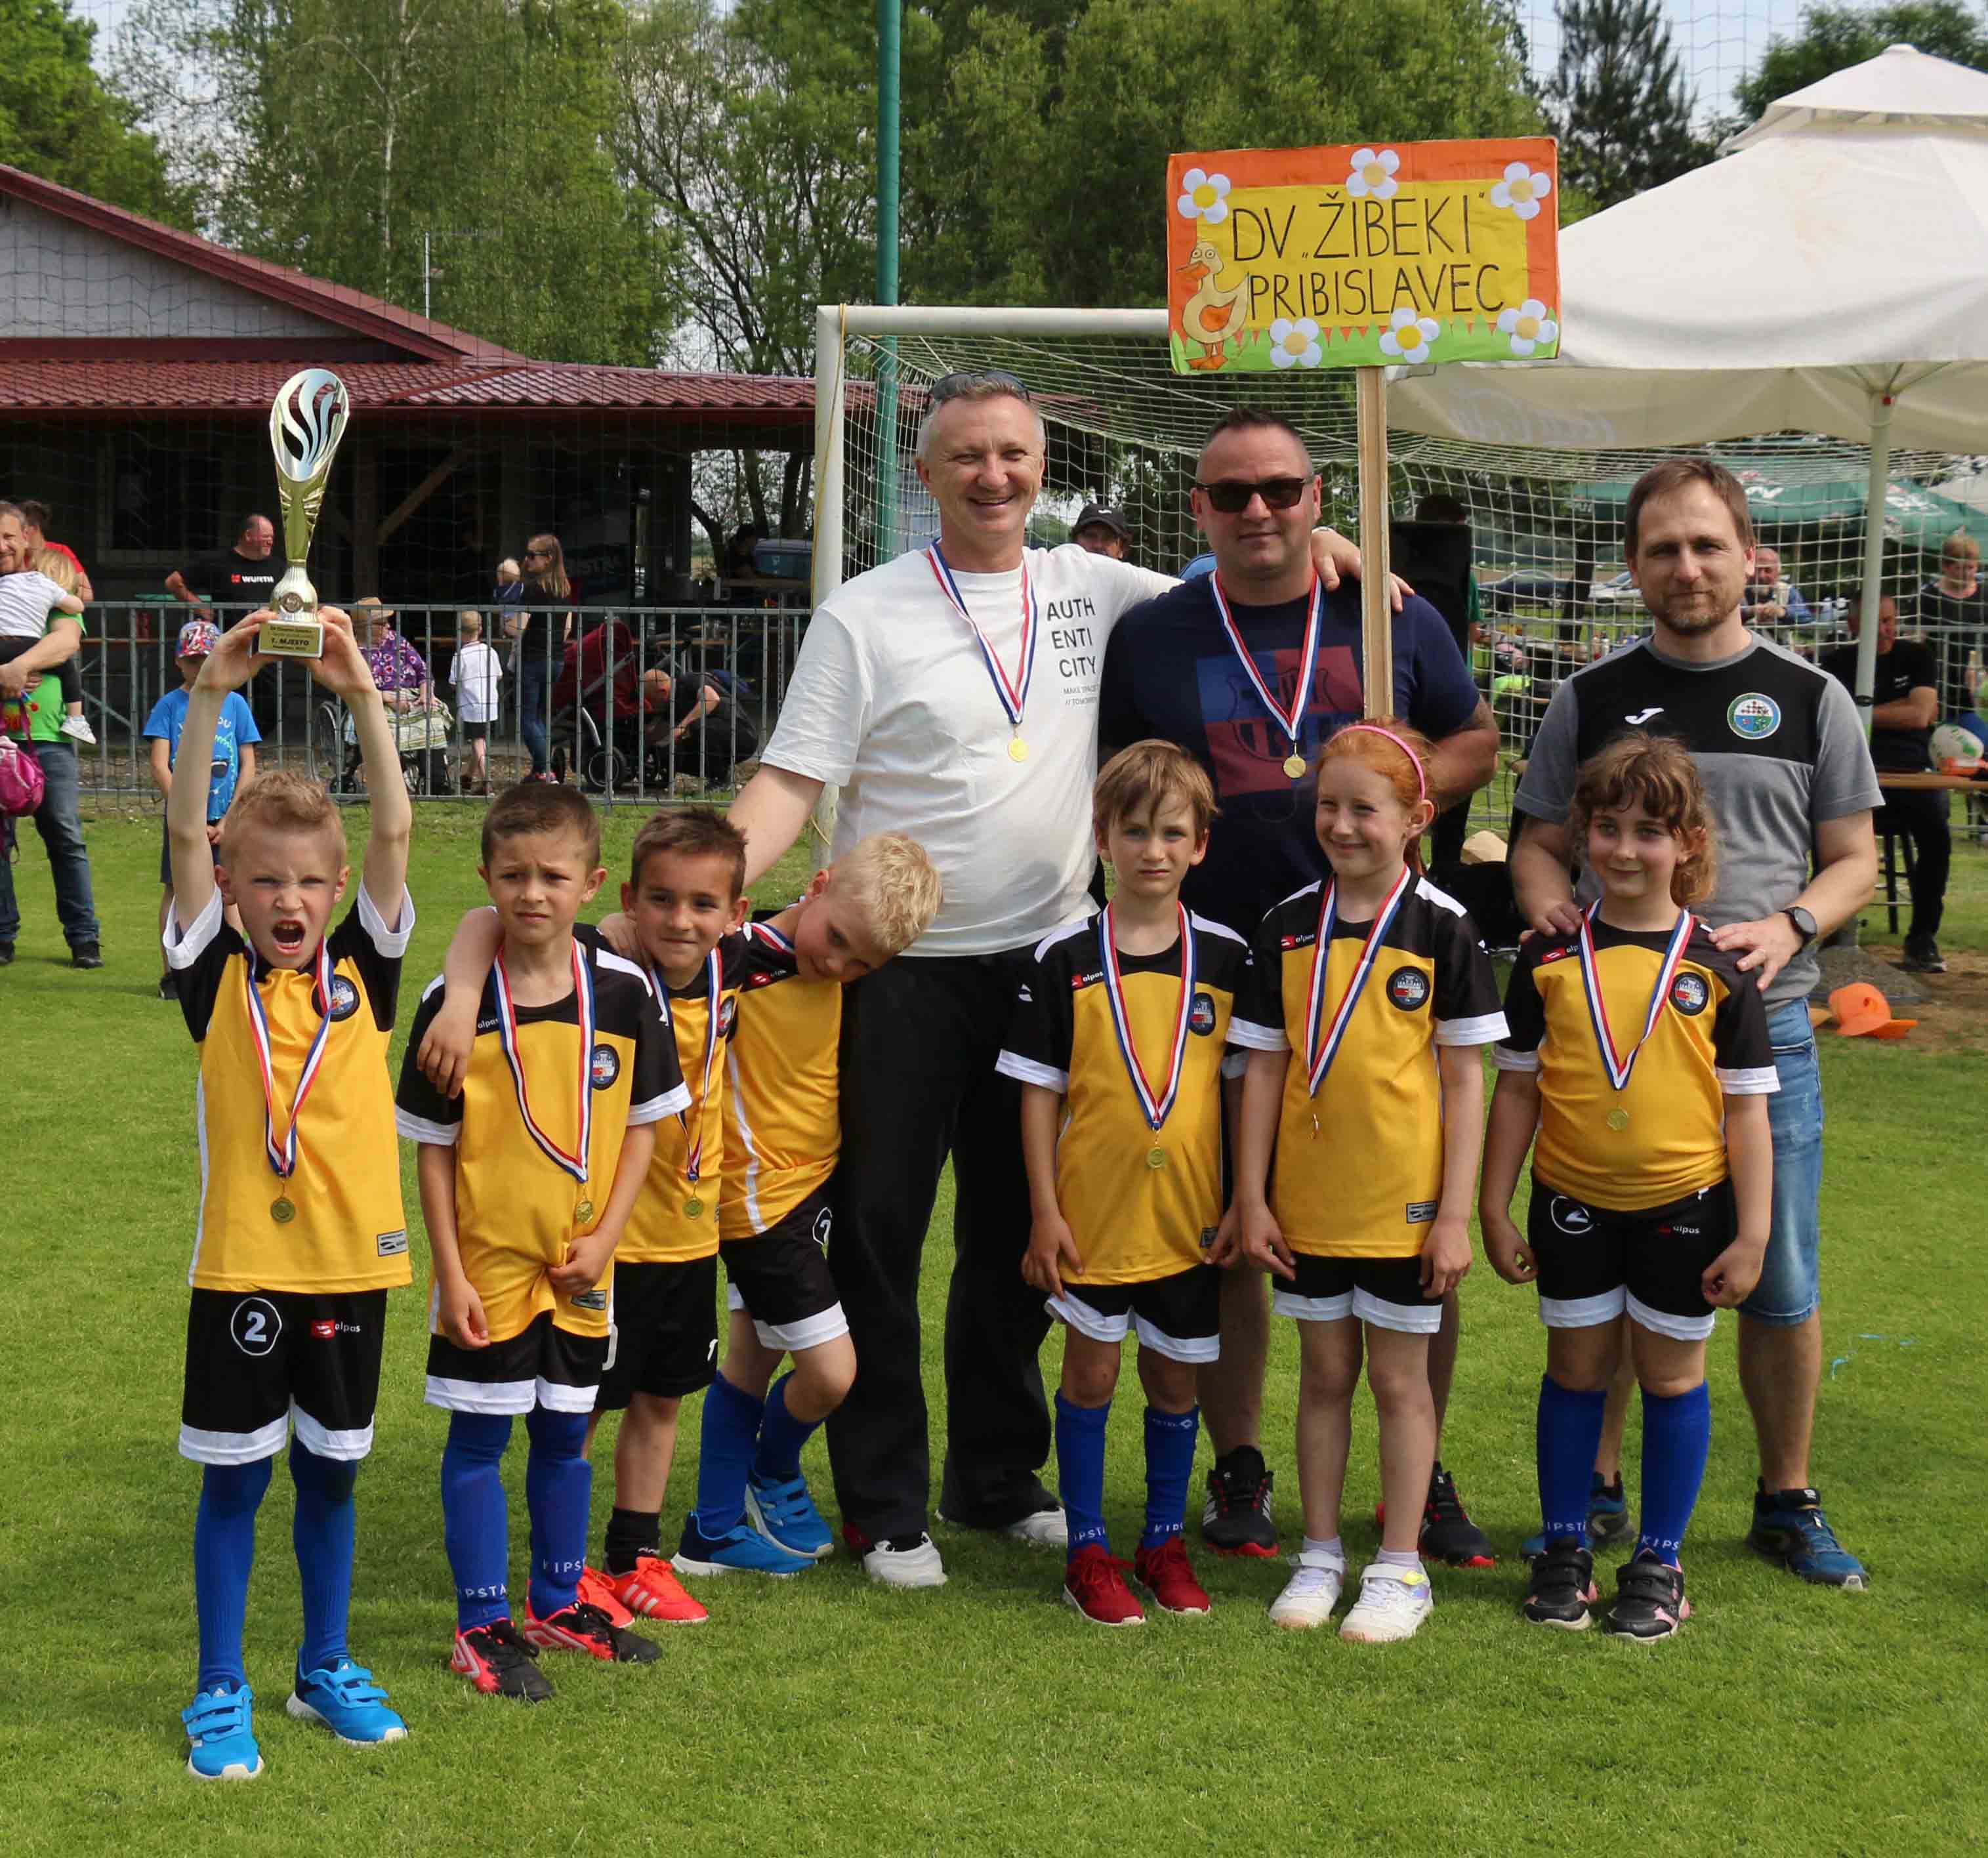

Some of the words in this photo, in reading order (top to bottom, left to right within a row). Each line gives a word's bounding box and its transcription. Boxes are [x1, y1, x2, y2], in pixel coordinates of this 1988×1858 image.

[1232, 205, 1296, 261] DV
[1249, 263, 1505, 321] PRIBISLAVEC
[1046, 598, 1096, 622] AUTH
[1051, 627, 1093, 650] ENTI
[1058, 655, 1096, 678] CITY
[245, 1311, 267, 1342] 2
